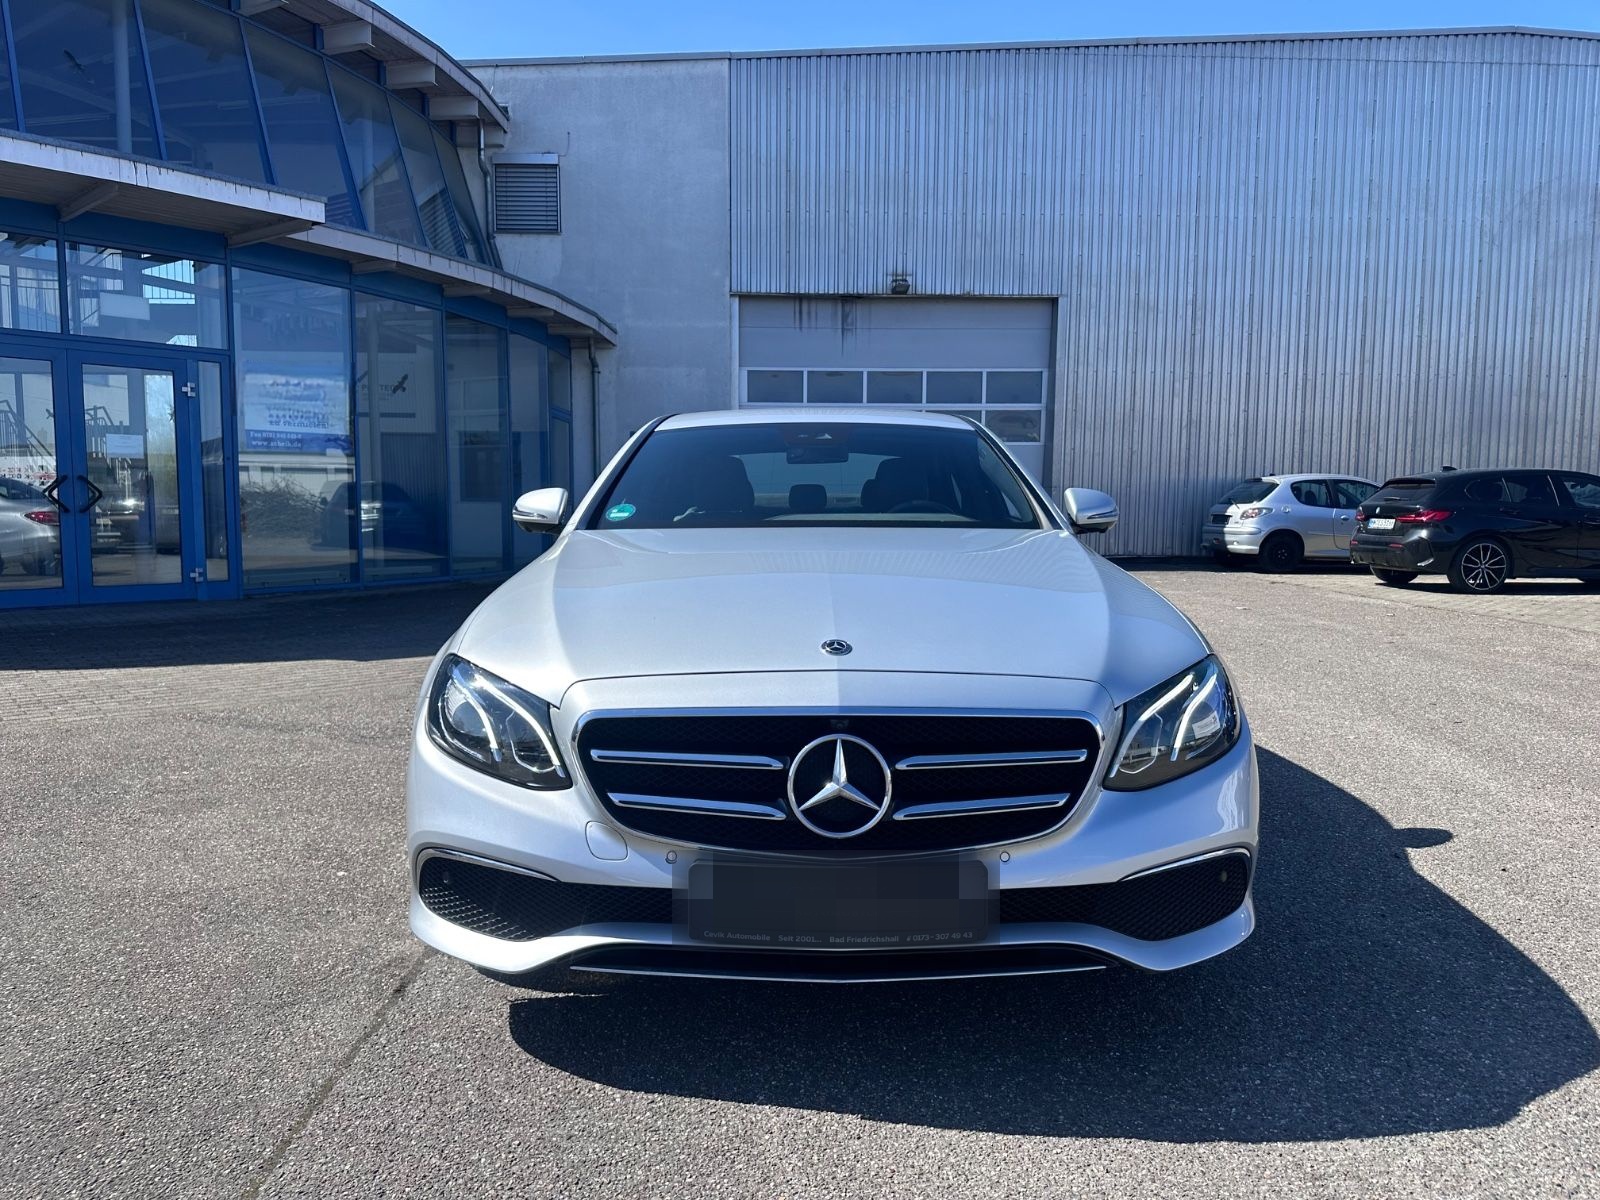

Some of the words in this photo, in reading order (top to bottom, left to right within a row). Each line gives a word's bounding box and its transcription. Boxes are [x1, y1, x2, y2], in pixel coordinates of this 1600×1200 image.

[703, 930, 725, 938] Cevik
[726, 932, 771, 941] Automobile
[778, 934, 794, 942] Seit
[846, 935, 899, 943] Friedrichshall
